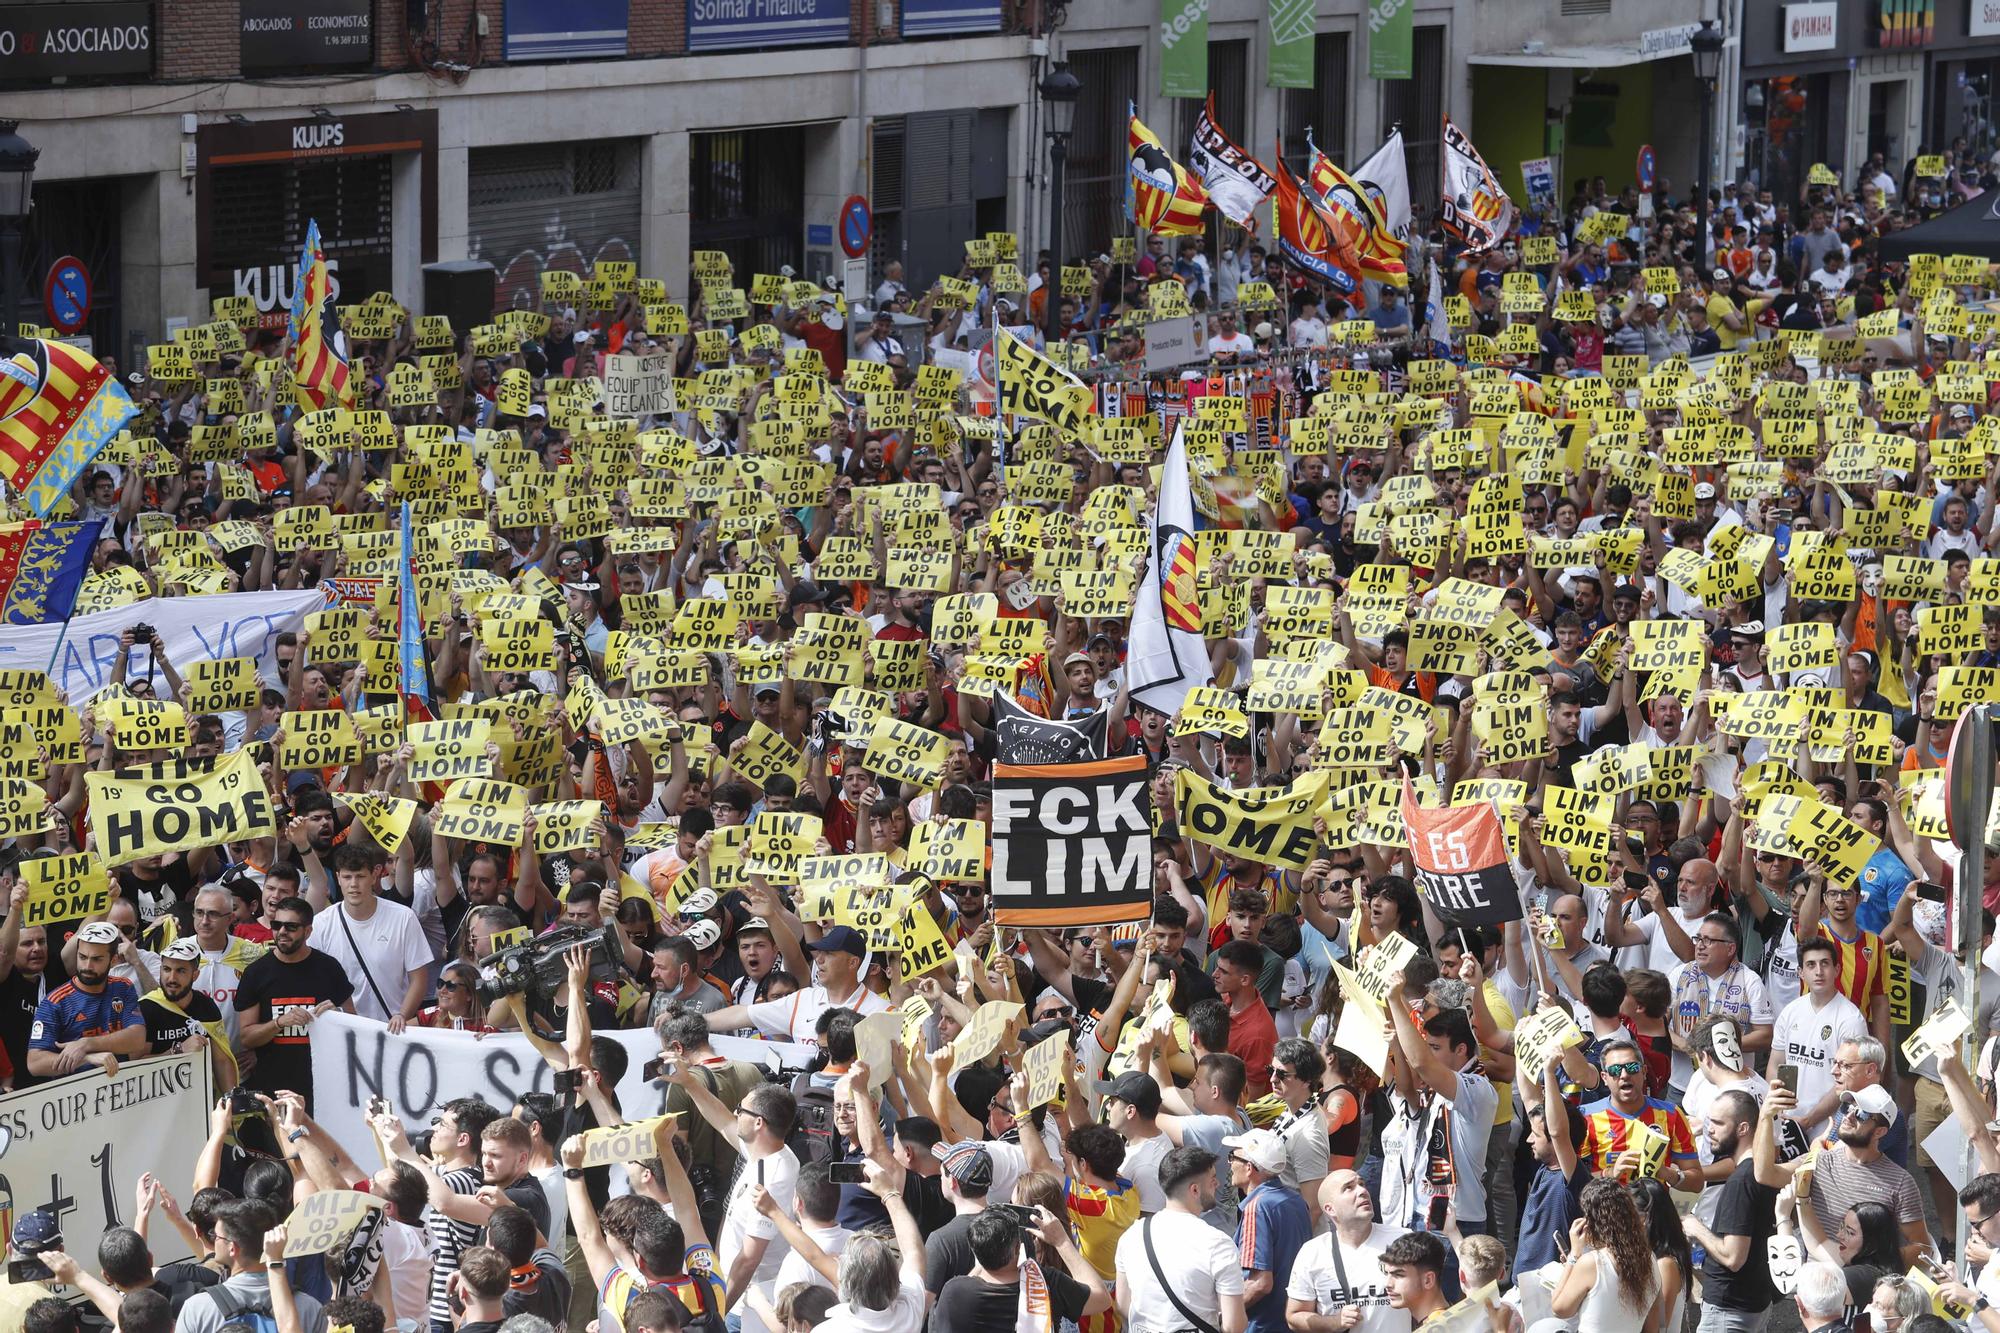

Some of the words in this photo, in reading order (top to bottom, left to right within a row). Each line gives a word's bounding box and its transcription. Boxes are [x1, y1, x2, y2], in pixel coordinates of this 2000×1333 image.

[694, 0, 751, 21] Solmar
[755, 0, 816, 17] Finance
[243, 18, 292, 31] ABOGADOS
[308, 15, 369, 29] ECONOMISTAS
[1801, 16, 1832, 38] YAMAHA
[43, 26, 149, 54] ASOCIADOS
[293, 123, 343, 149] KUUPS
[550, 272, 573, 283] LIM
[1649, 268, 1670, 278] LIM
[234, 259, 340, 313] KUUS
[556, 282, 569, 290] GO
[1647, 283, 1678, 293] HOME
[545, 289, 581, 300] HOME
[715, 290, 734, 300] LIM
[720, 300, 733, 308] GO
[158, 346, 184, 359] LIM
[165, 359, 179, 367] GO
[153, 367, 193, 378] HOME
[395, 371, 422, 384] LIM
[925, 367, 953, 380] LIM
[403, 384, 418, 393] GO
[500, 377, 509, 404] LIM
[509, 382, 517, 398] GO
[931, 380, 946, 388] GO
[392, 392, 435, 405] HOME
[517, 371, 529, 414] HOME
[918, 387, 957, 401] HOME
[568, 496, 598, 512] LIM
[285, 507, 321, 523] LIM
[577, 510, 596, 522] GO
[1475, 513, 1511, 529] LIM
[294, 523, 314, 534] GO
[563, 520, 614, 540] HOME
[1486, 529, 1504, 539] GO
[278, 535, 333, 550] HOME
[827, 539, 860, 553] LIM
[1243, 533, 1282, 549] LIM
[1470, 538, 1524, 554] HOME
[836, 554, 855, 564] GO
[1251, 548, 1272, 559] GO
[1231, 560, 1291, 576] HOME
[1805, 555, 1843, 570] LIM
[818, 565, 873, 578] HOME
[1814, 571, 1834, 581] GO
[1075, 572, 1116, 588] LIM
[1085, 588, 1106, 600] GO
[1794, 582, 1853, 597] HOME
[1065, 600, 1128, 614] HOME
[497, 621, 539, 638] LIM
[1779, 624, 1818, 642] LIM
[507, 639, 531, 651] GO
[1790, 641, 1811, 652] GO
[486, 652, 552, 669] HOME
[1772, 649, 1835, 670] HOME
[122, 700, 166, 716] LIM
[1742, 692, 1791, 709] LIM
[136, 715, 160, 728] GO
[1751, 709, 1777, 720] GO
[422, 721, 473, 742] LIM
[1010, 723, 1041, 736] HEY
[1725, 720, 1798, 737] HOME
[118, 727, 186, 747] HOME
[889, 723, 940, 752] LIM
[434, 741, 462, 756] GO
[895, 744, 921, 761] GO
[411, 755, 487, 779] HOME
[865, 750, 938, 787] HOME
[145, 782, 203, 804] GO
[459, 780, 513, 804] LIM
[992, 781, 1150, 835] FCK
[1555, 789, 1598, 813] LIM
[468, 802, 497, 817] GO
[107, 790, 271, 858] HOME
[1564, 811, 1586, 826] GO
[438, 815, 521, 842] HOME
[1810, 808, 1863, 847] LIM
[1543, 824, 1606, 849] HOME
[1814, 833, 1841, 853] GO
[992, 834, 1151, 896] LIM
[1787, 834, 1855, 883] HOME
[40, 855, 89, 882] LIM
[53, 879, 81, 896] GO
[28, 891, 107, 922] HOME
[1373, 957, 1387, 970] GO
[1355, 968, 1389, 1002] HOME
[1890, 952, 1907, 1021] HOME
[1540, 1009, 1569, 1037] LIM
[1532, 1029, 1548, 1046] GO
[1518, 1033, 1544, 1076] HOME
[346, 1028, 437, 1121] NO
[41, 1091, 88, 1132] OUR
[94, 1061, 193, 1118] FEELING
